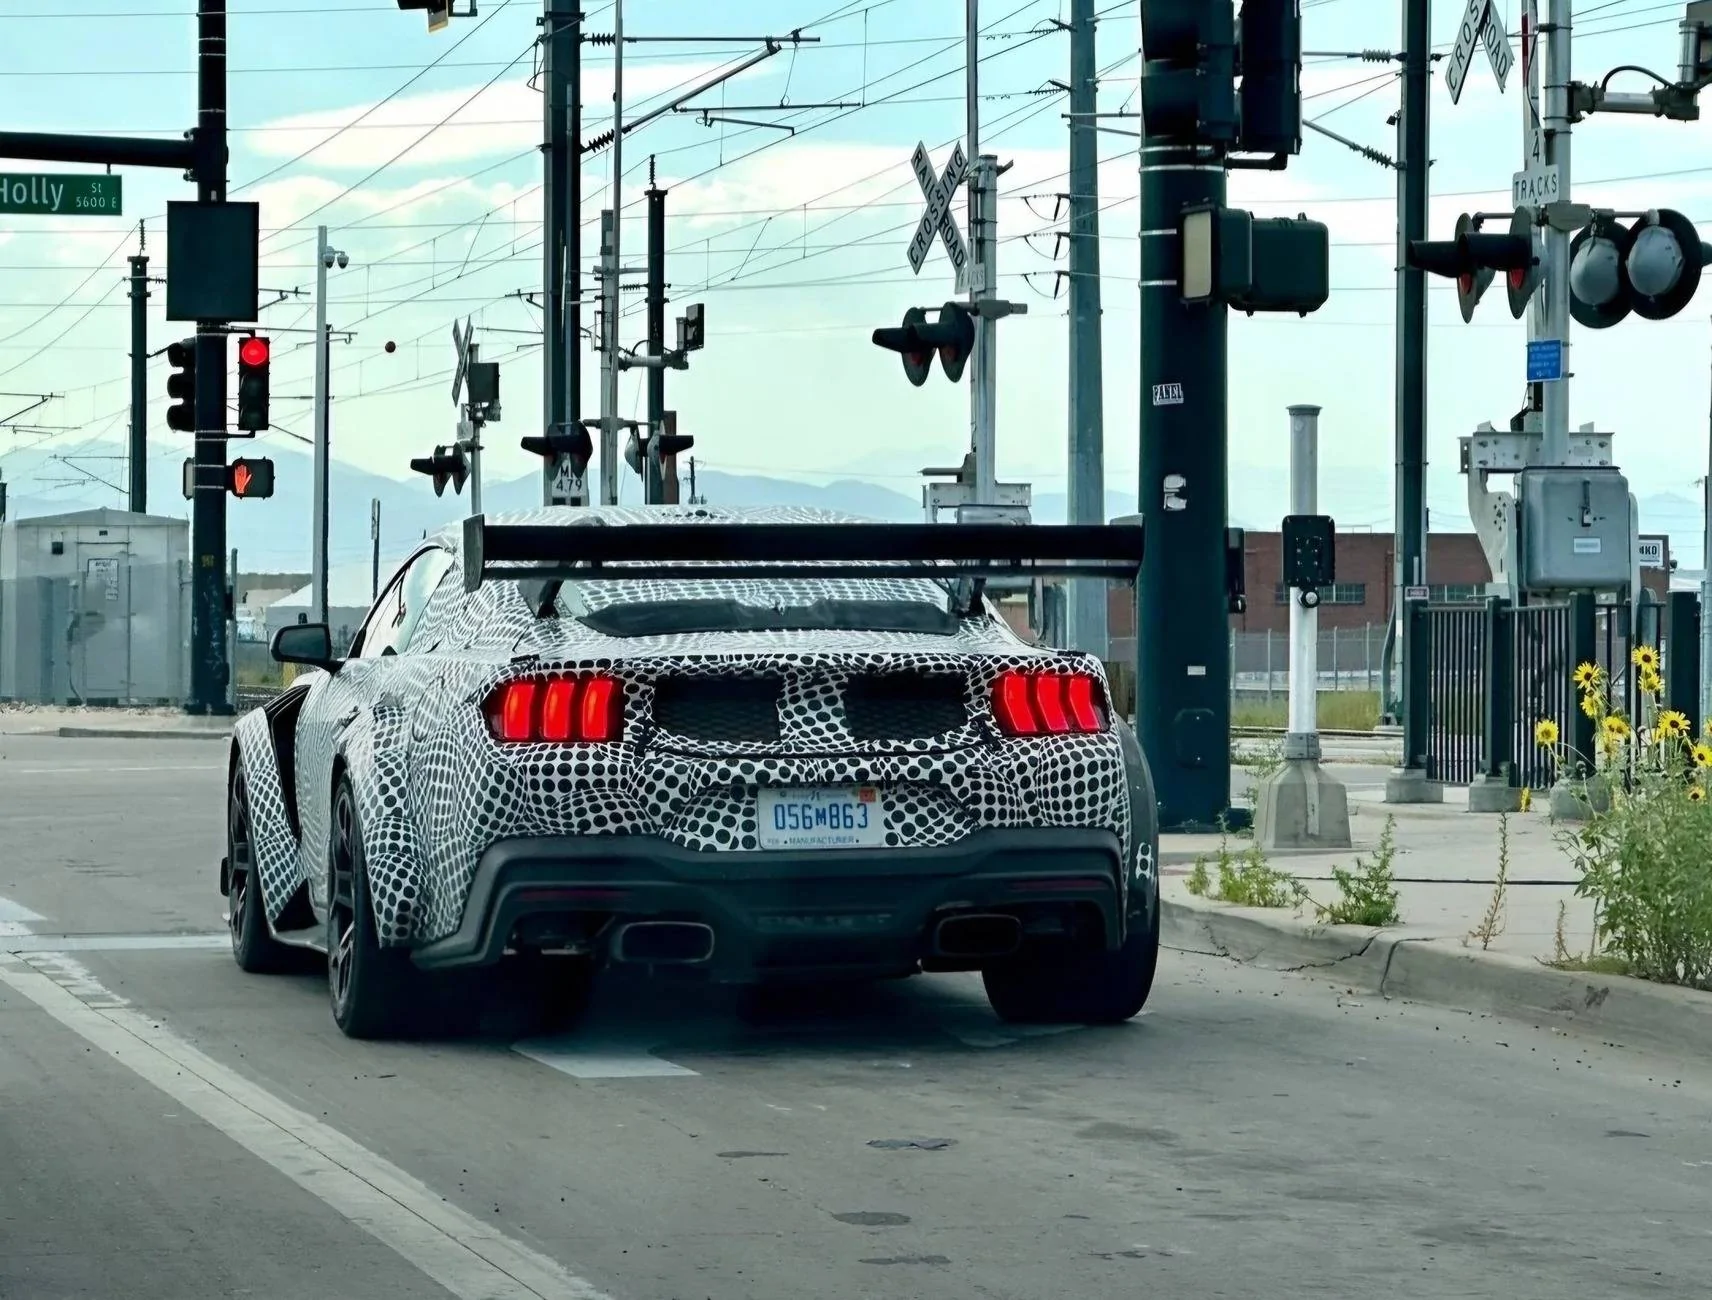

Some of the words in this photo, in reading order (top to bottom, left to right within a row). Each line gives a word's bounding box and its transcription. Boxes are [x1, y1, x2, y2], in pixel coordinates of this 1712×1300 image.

[1533, 136, 1539, 163] 4
[0, 176, 63, 212] Holly
[75, 197, 105, 208] 5600
[1515, 173, 1557, 201] TRACKS
[910, 151, 963, 265] CROSSING
[914, 149, 936, 199] RAIL
[940, 211, 964, 268] ROAD
